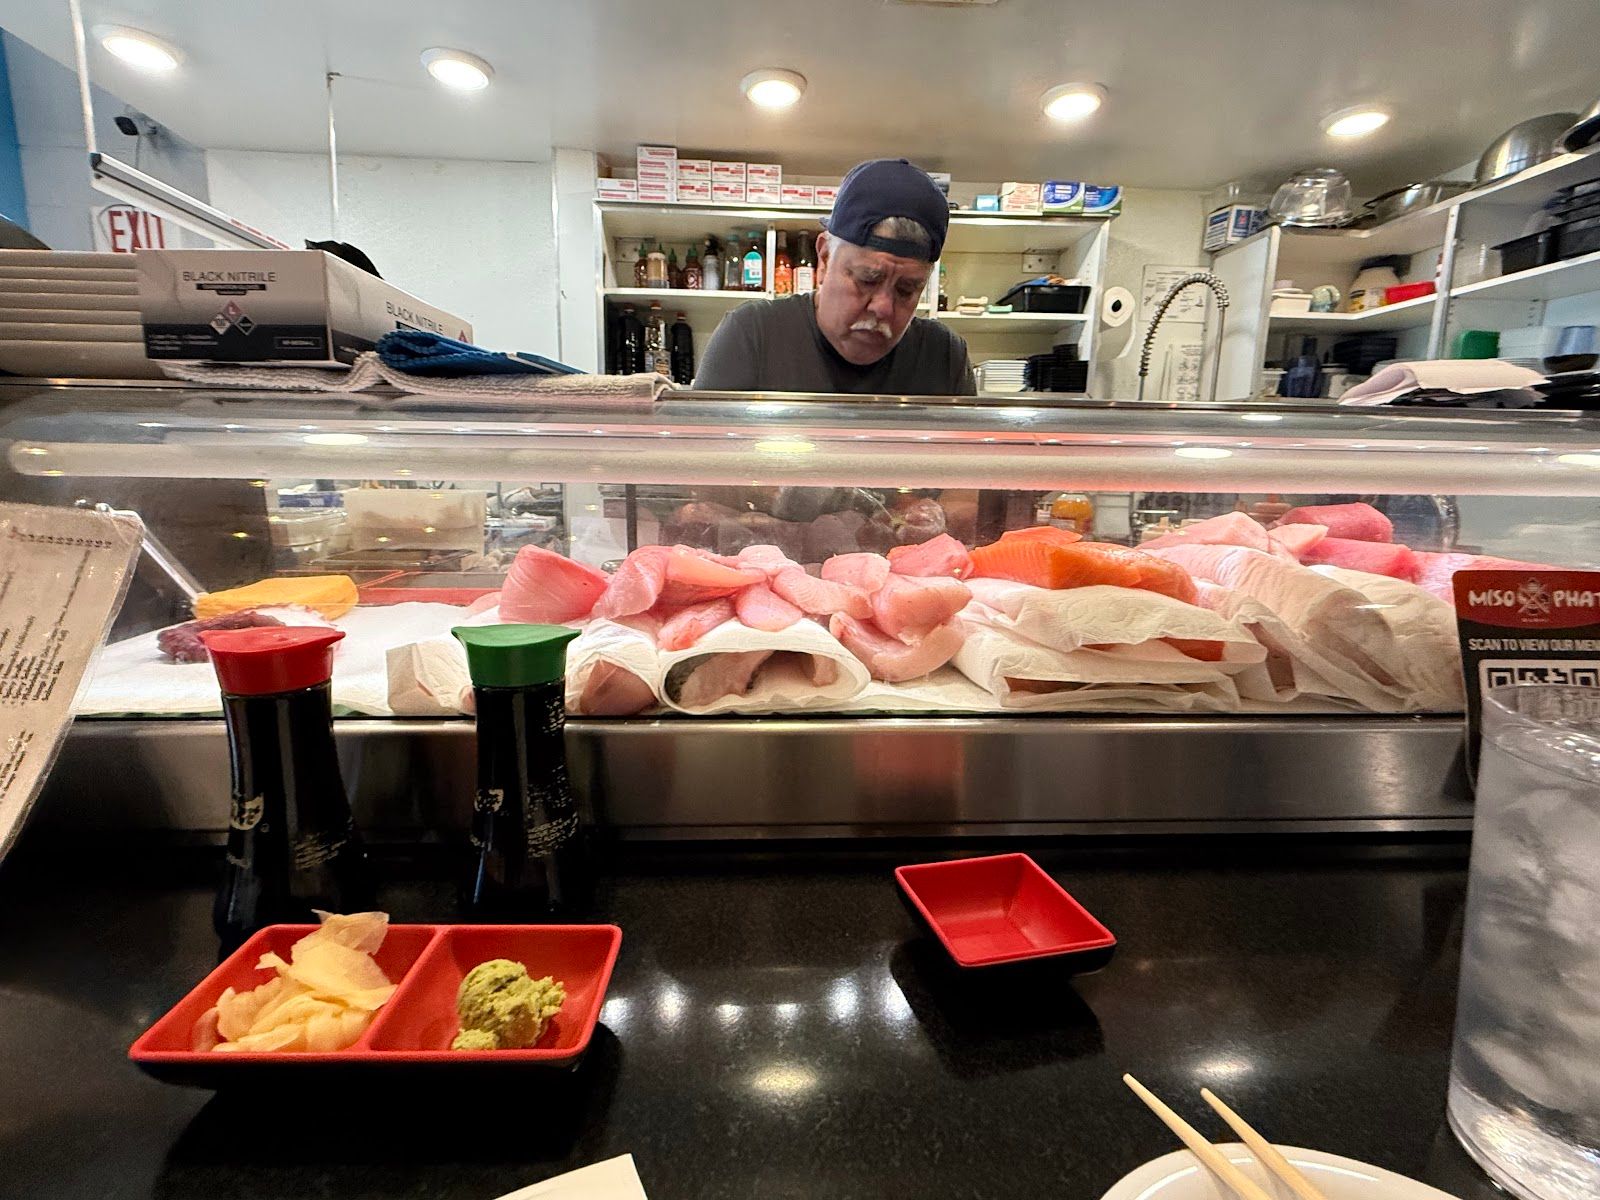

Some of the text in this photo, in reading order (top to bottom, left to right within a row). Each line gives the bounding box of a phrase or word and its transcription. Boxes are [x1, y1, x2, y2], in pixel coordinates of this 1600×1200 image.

[108, 210, 164, 253] EXIT
[182, 271, 277, 283] BLACK NITRILE
[385, 301, 415, 323] BLACK
[415, 312, 444, 332] NITRILE
[1468, 589, 1516, 607] MISO
[1468, 638, 1600, 652] SCAN TO VIEW OUR MEN
